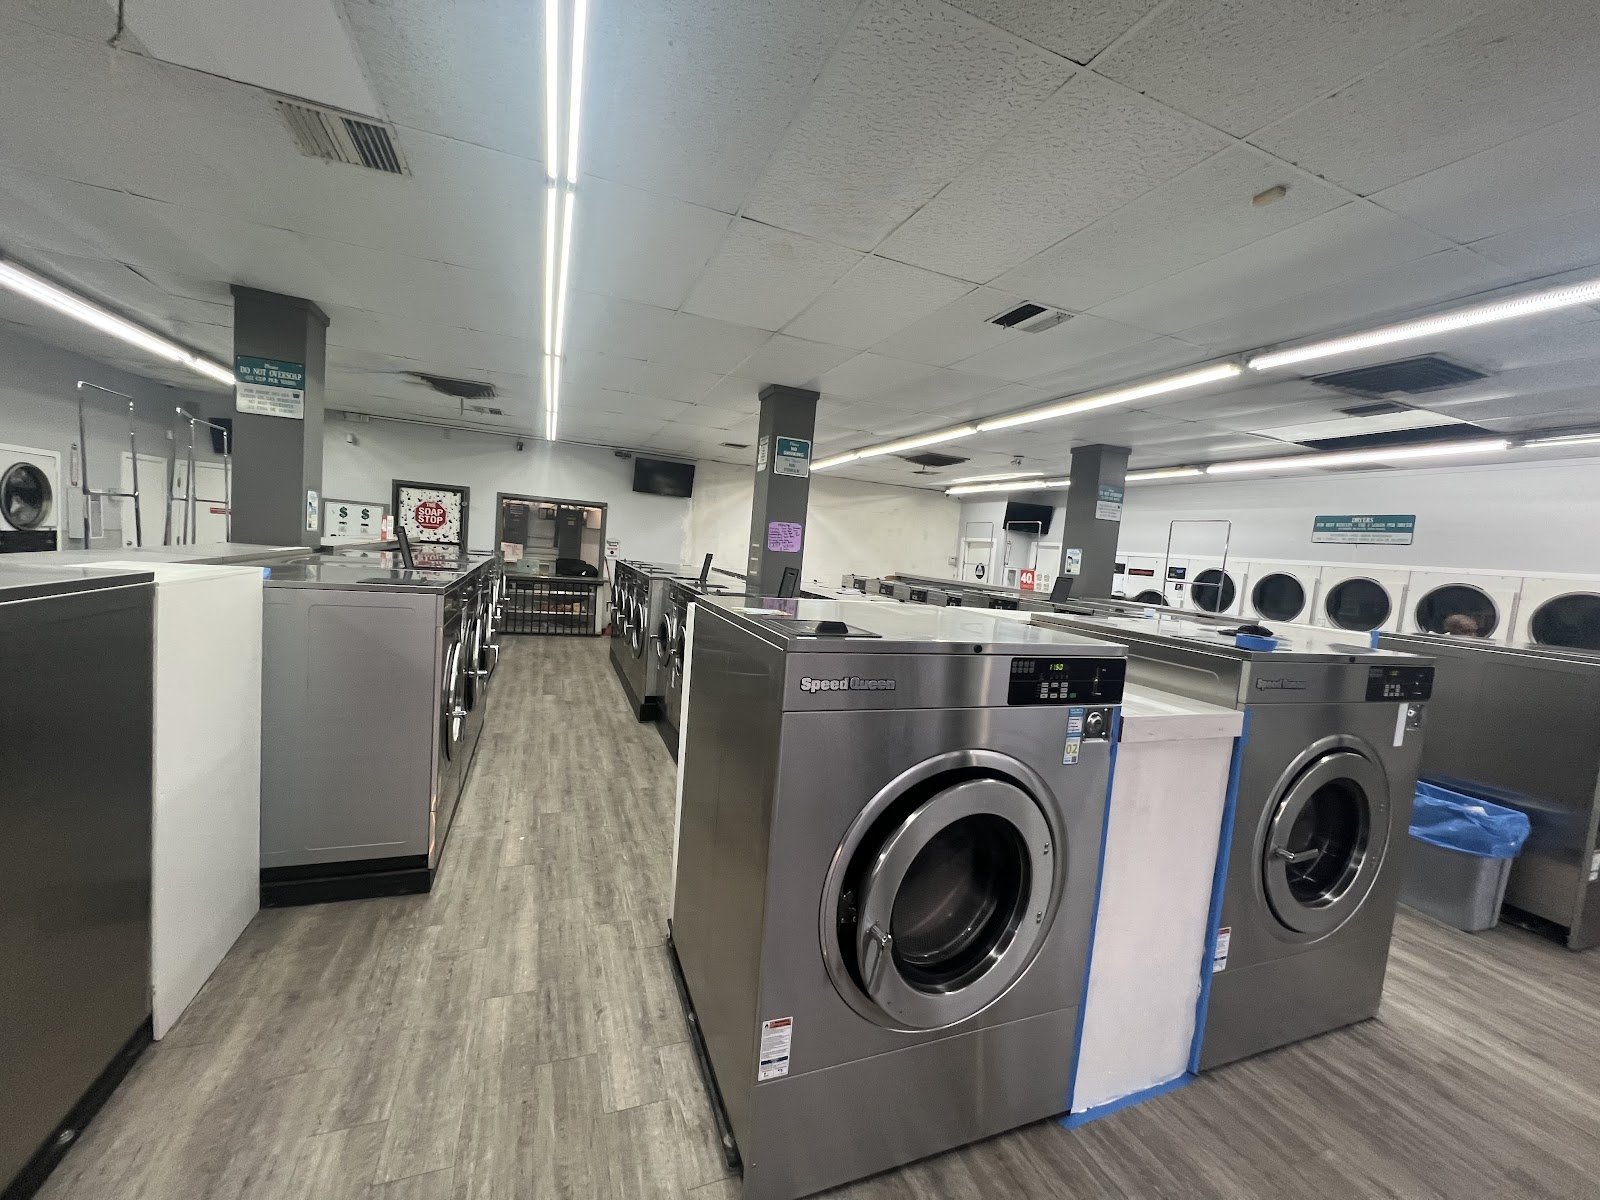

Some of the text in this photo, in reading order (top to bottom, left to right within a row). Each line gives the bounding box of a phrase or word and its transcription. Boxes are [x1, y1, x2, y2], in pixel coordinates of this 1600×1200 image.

[240, 366, 302, 381] DO NOT OVERSOAP
[418, 507, 443, 517] SOAP
[418, 514, 443, 525] STOP
[800, 676, 896, 693] Speed Queen
[1065, 743, 1079, 755] 02
